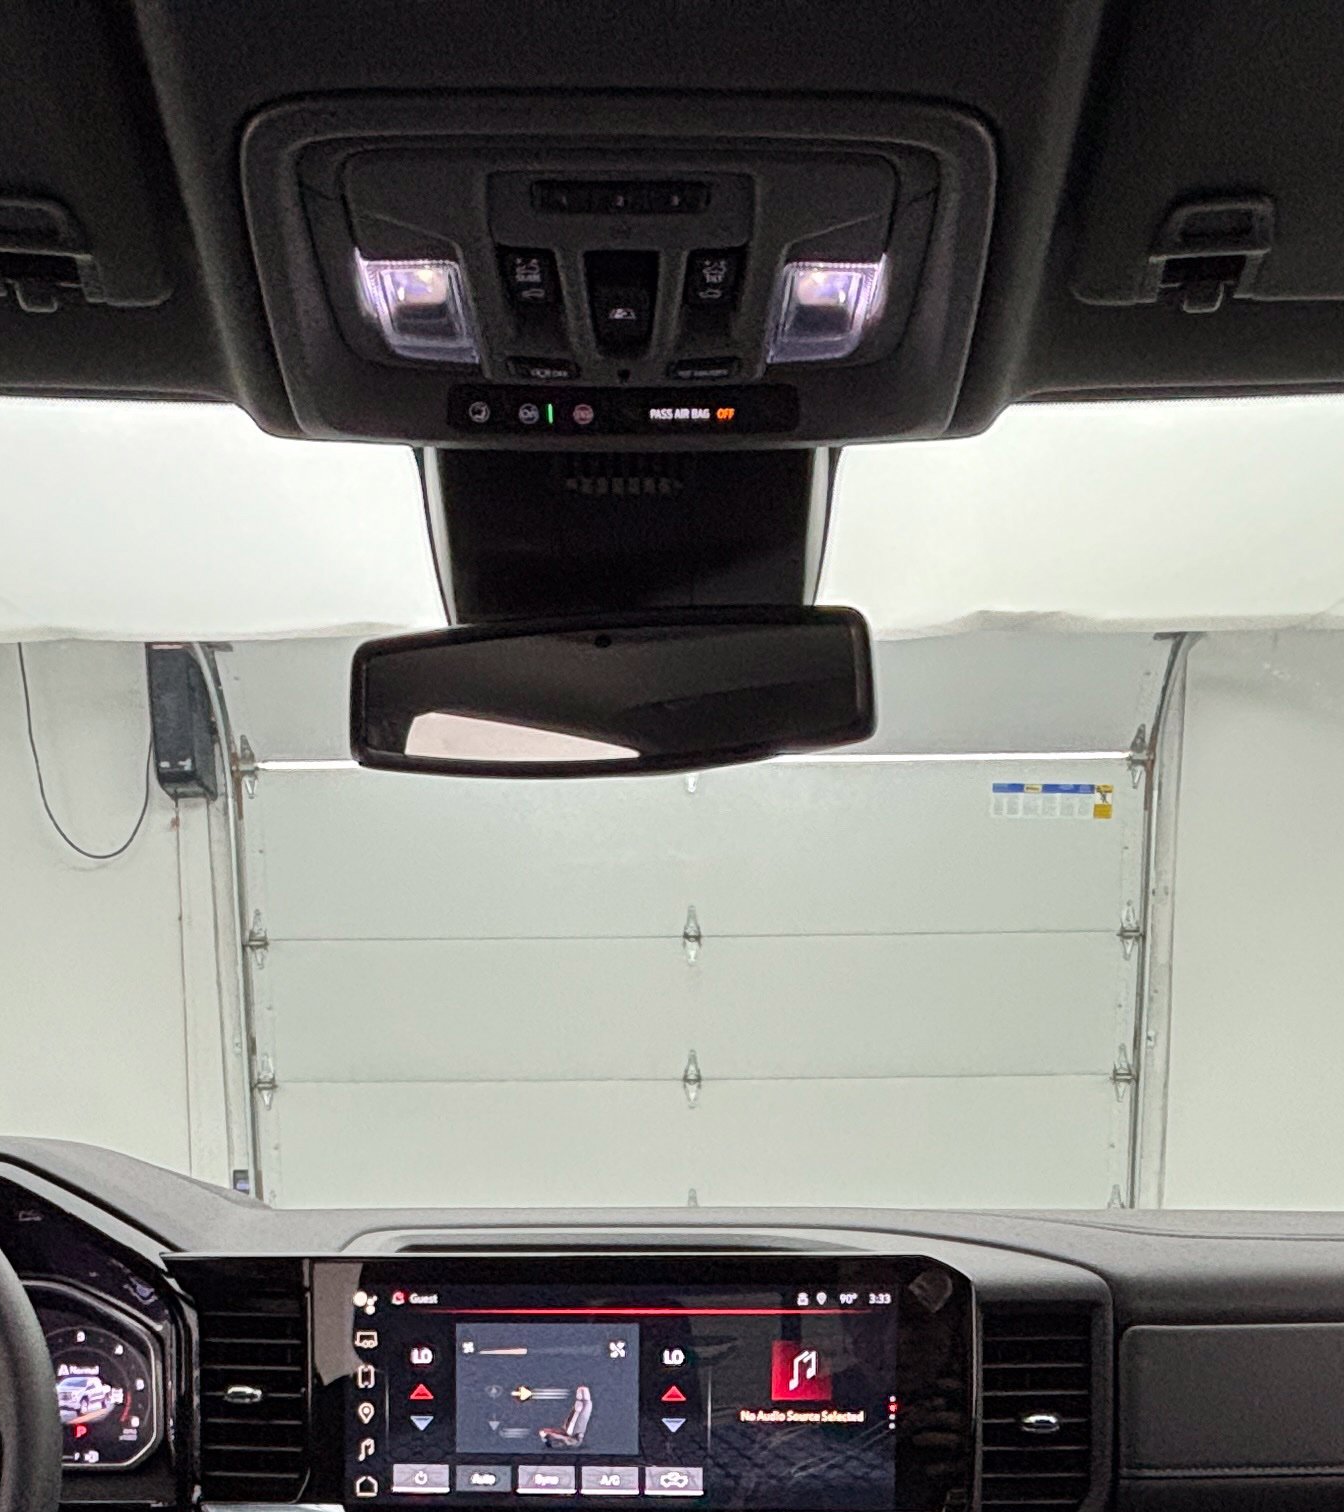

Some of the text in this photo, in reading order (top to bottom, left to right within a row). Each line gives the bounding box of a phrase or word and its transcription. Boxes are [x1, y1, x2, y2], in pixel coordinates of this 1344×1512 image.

[649, 407, 735, 420] PASS AIR BAG OFF
[409, 1293, 439, 1305] Guest
[868, 1293, 893, 1305] 3:33
[411, 1347, 434, 1365] LO
[662, 1348, 685, 1366] LO
[739, 1410, 864, 1422] No Audio Source Selected
